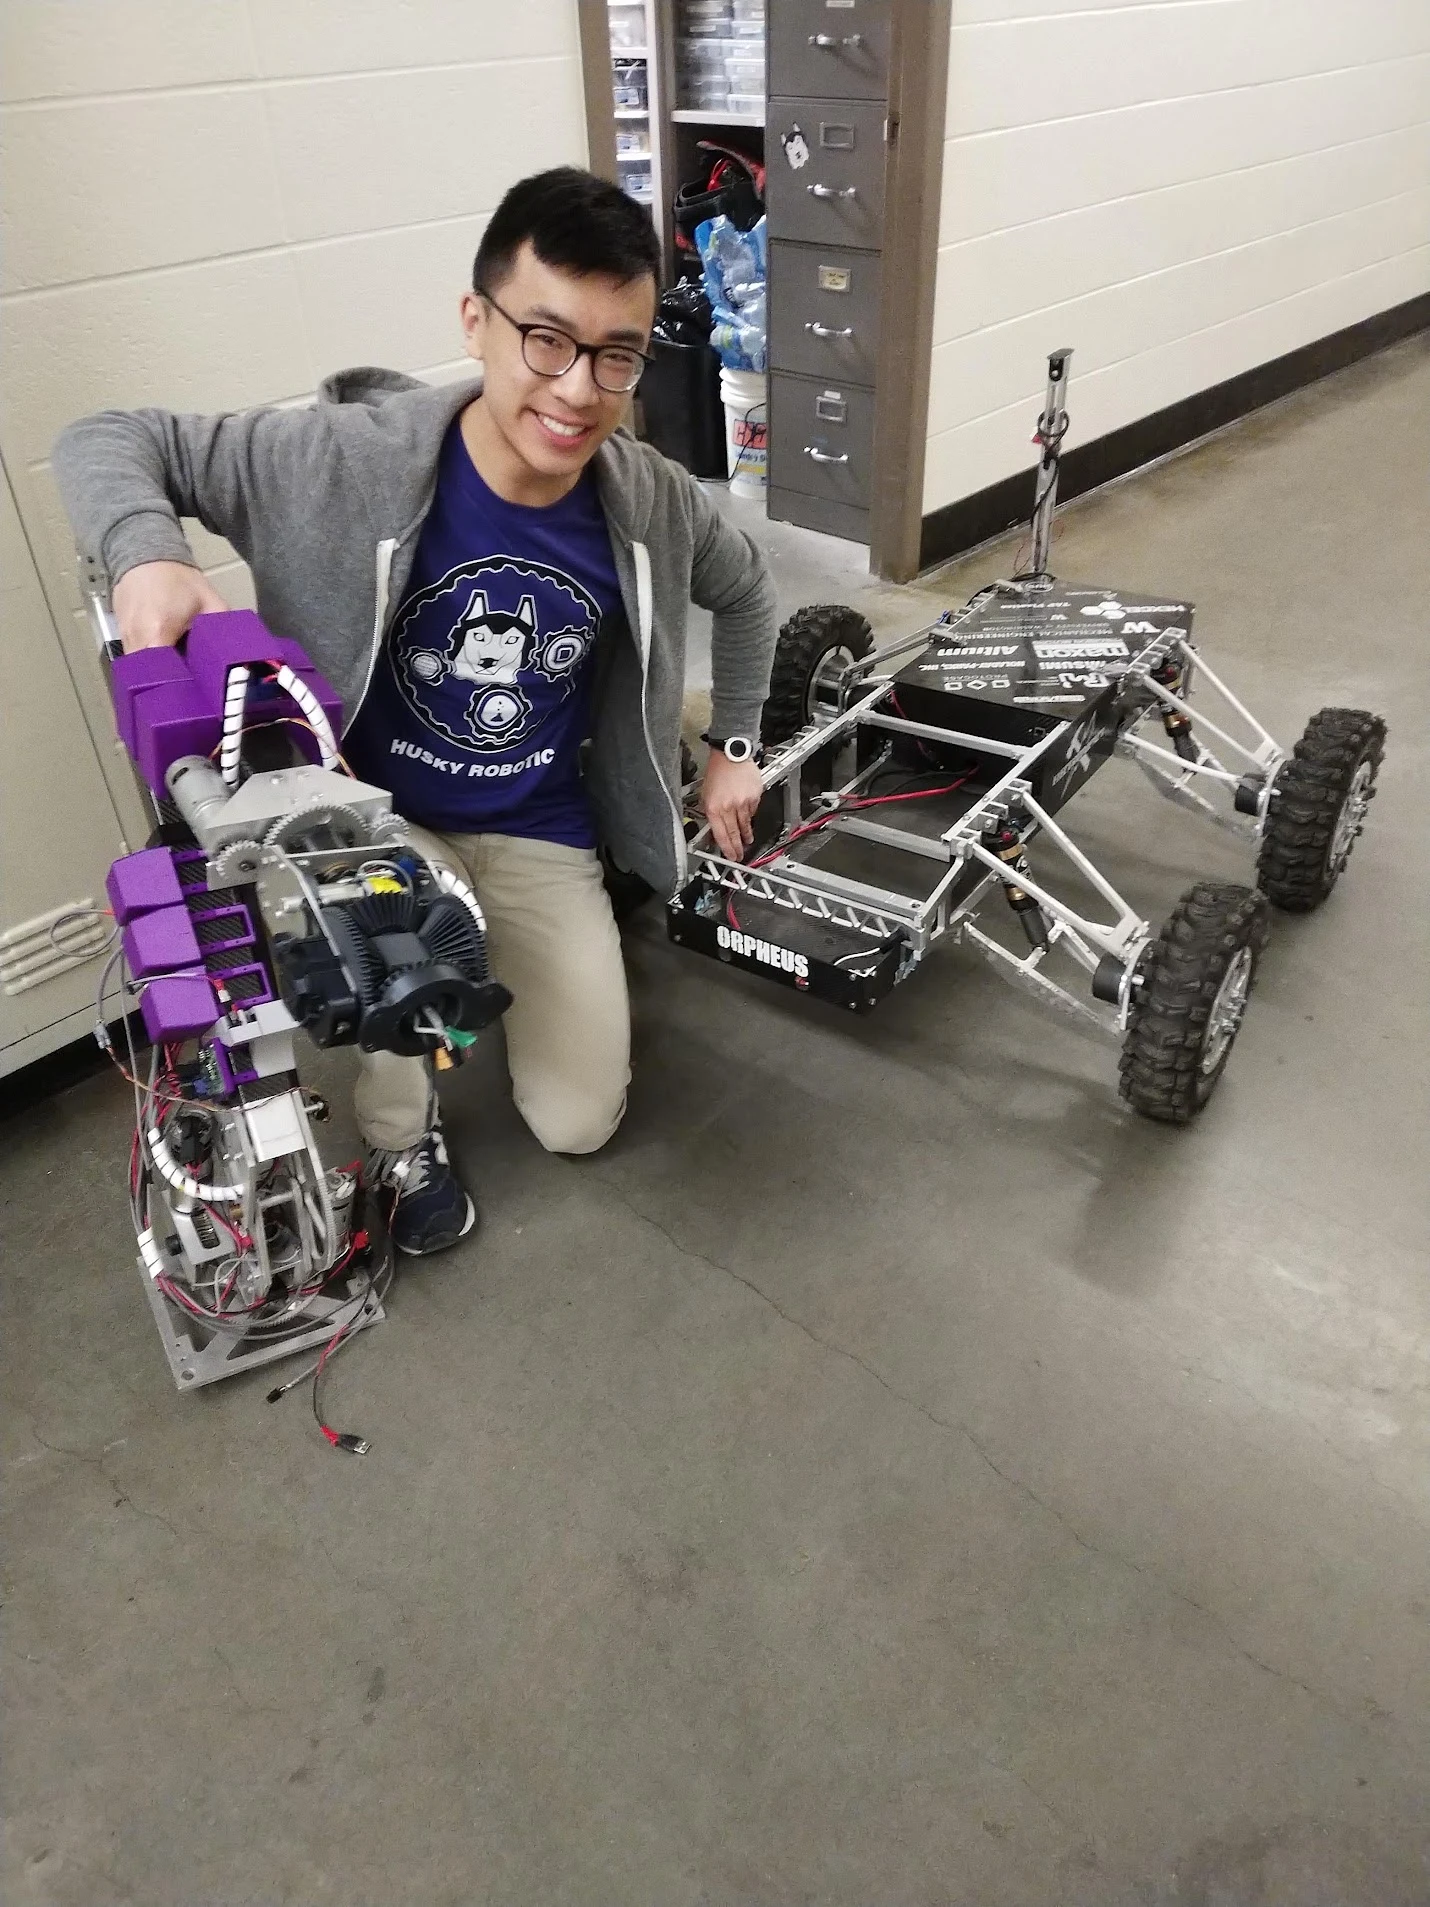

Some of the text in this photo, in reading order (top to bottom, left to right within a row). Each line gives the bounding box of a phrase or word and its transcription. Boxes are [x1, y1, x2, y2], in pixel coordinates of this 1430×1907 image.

[937, 645, 1019, 656] Altium
[1036, 647, 1130, 658] maxon
[390, 738, 556, 777] HUSKY ROBOTIC
[717, 925, 809, 978] ORPHEUS
